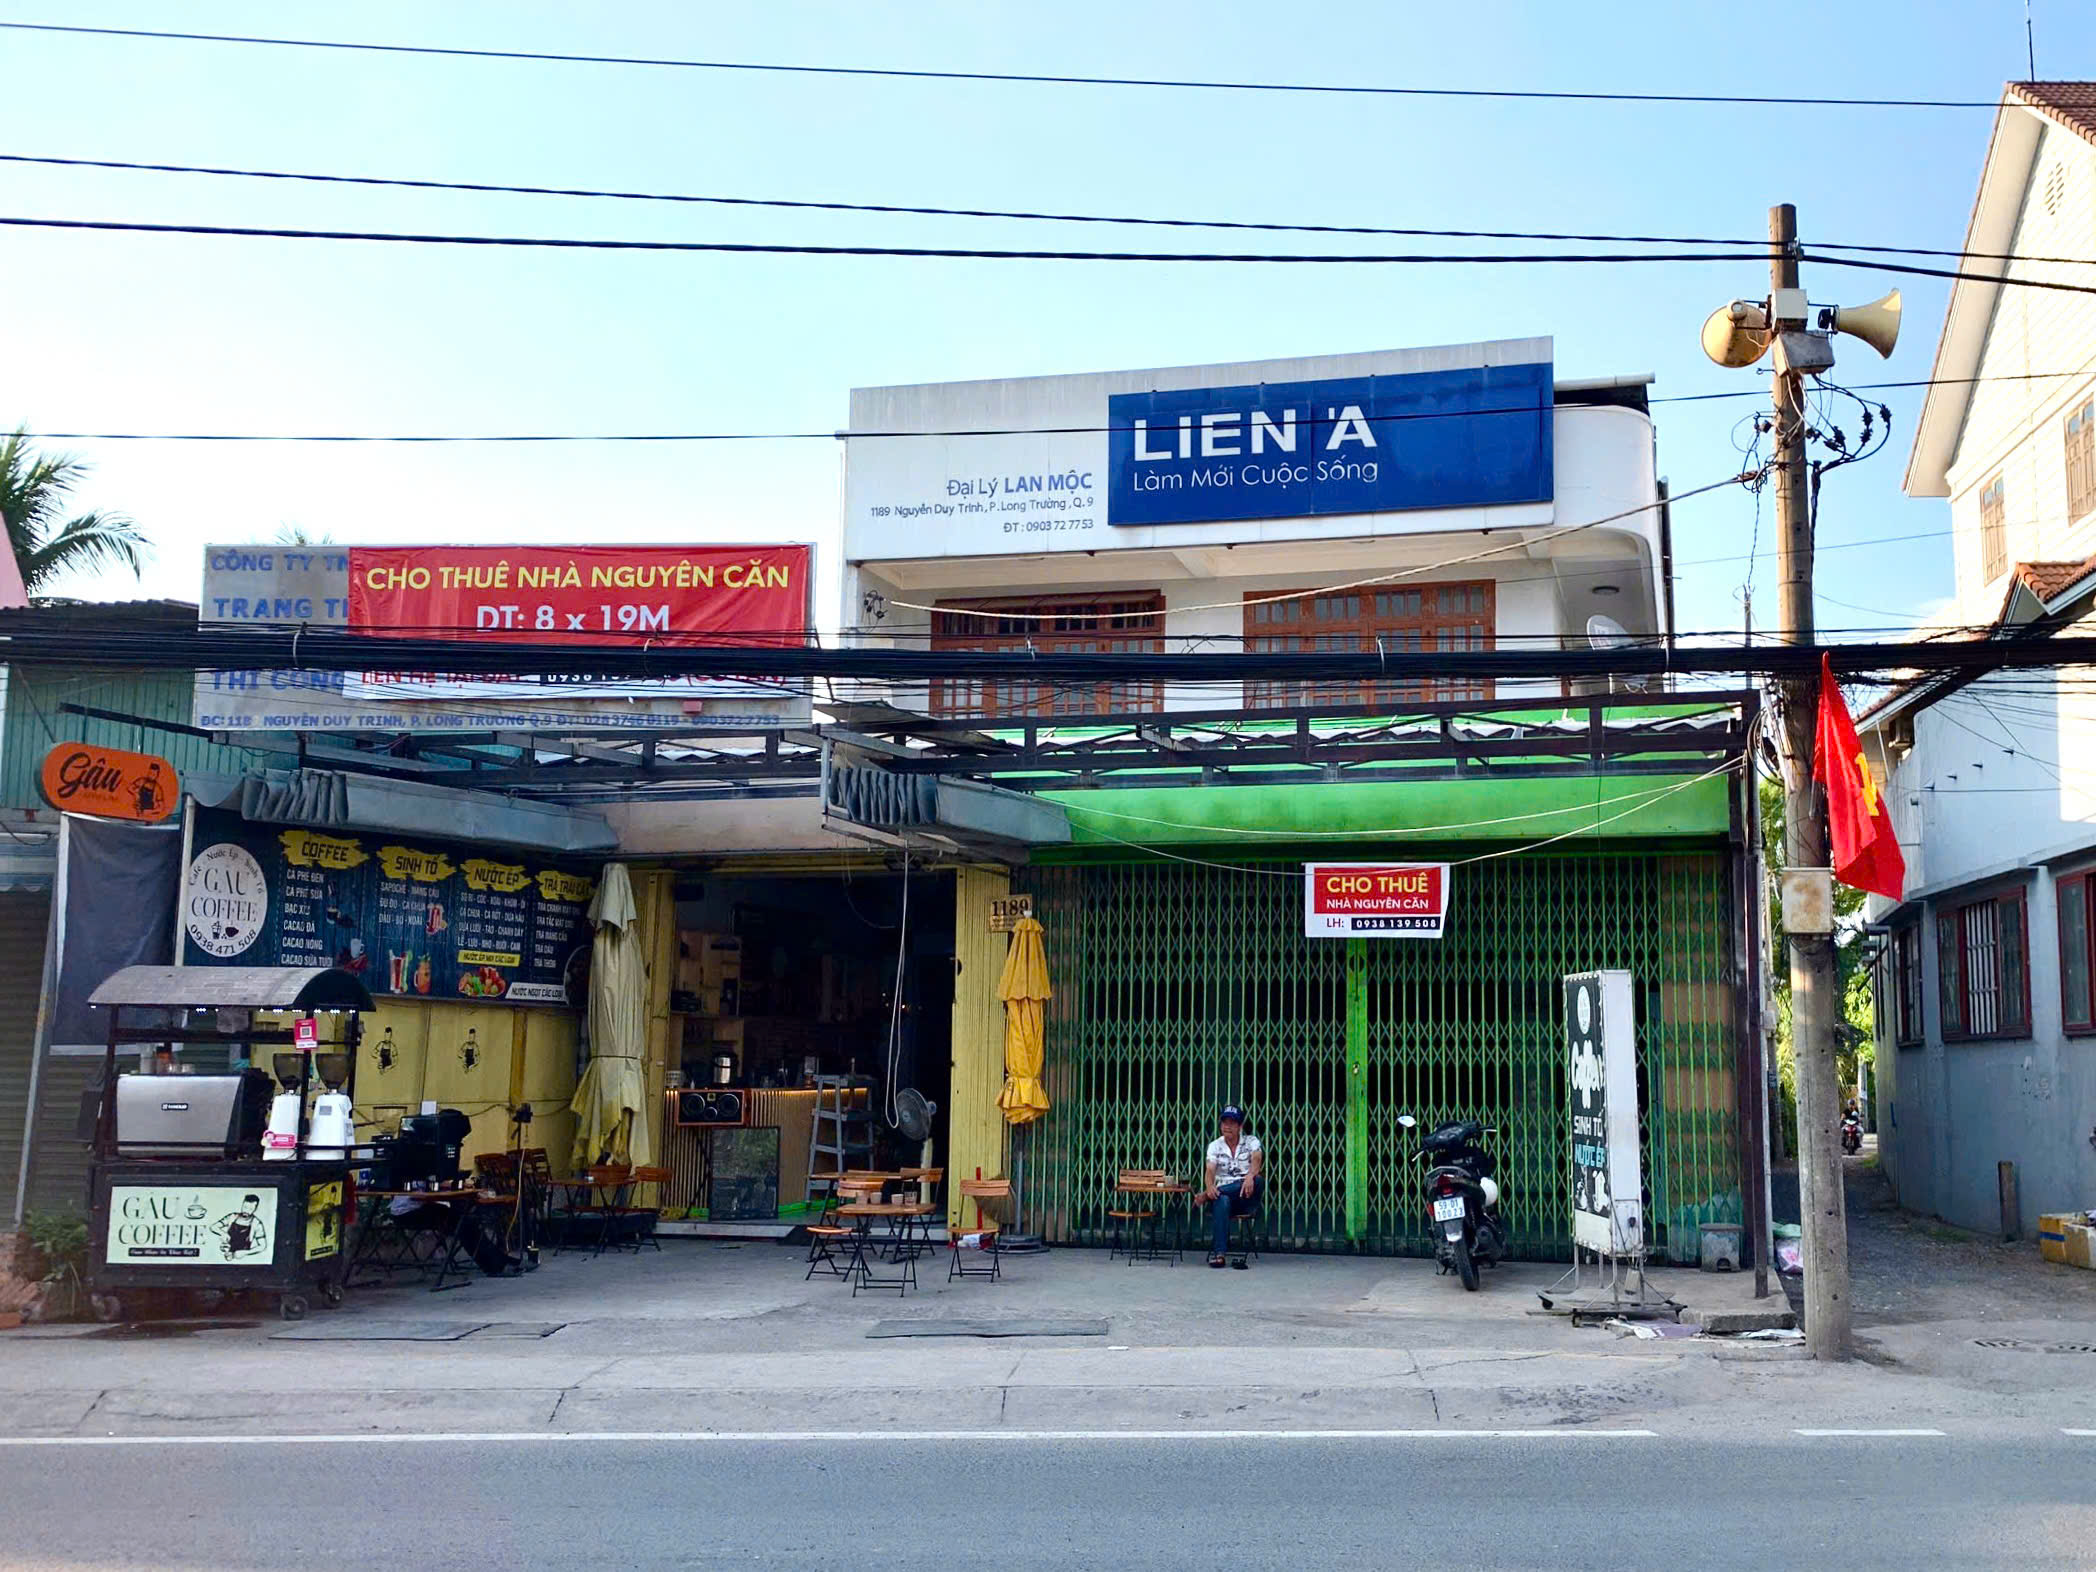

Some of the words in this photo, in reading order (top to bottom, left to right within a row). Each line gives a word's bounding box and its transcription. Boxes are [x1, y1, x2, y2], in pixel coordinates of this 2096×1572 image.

[1134, 408, 1296, 462] LIEN
[946, 479, 974, 499] Đại
[978, 477, 998, 498] Lý
[1004, 475, 1042, 493] LAN
[1048, 469, 1093, 494] MỘC
[1134, 470, 1183, 492] Làm
[1191, 464, 1234, 487] Mới
[1241, 462, 1309, 489] Cuộc
[1316, 455, 1378, 483] Sống
[871, 506, 891, 517] 1189
[934, 503, 955, 516] Duy
[1026, 521, 1052, 532] 0903
[1068, 518, 1094, 530] 7753
[211, 549, 273, 572] CÔNG
[284, 555, 313, 571] TY
[367, 567, 431, 591] CHO
[439, 561, 508, 589] THUÊ
[518, 560, 582, 588] NHÀ
[591, 561, 714, 589] NGUYÊN
[723, 559, 789, 589] CĂN
[213, 598, 313, 619] TRANG
[535, 605, 555, 631] 8
[565, 612, 586, 630] x
[600, 605, 670, 632] 19M
[211, 671, 259, 690] THI
[323, 715, 353, 726] DUY
[426, 714, 463, 726] LONG
[301, 841, 349, 862] COFFEE
[395, 856, 422, 873] SINH
[425, 855, 440, 875] TỐ
[474, 867, 505, 884] NƯỚC
[506, 870, 520, 886] ÉP
[1327, 876, 1372, 893] CHO
[1377, 871, 1429, 893] THUÊ
[191, 896, 258, 922] COFFEE
[992, 898, 1029, 917] 1189
[1326, 896, 1352, 909] NHÀ
[1354, 896, 1401, 909] NGUYÊN
[1403, 897, 1429, 909] CĂN
[283, 919, 305, 932] CACAO
[1326, 918, 1344, 928] LH:
[1356, 919, 1385, 928] 0938
[1389, 919, 1411, 928] 139
[1415, 919, 1437, 928] 508
[190, 924, 215, 952] 0938
[215, 945, 236, 955] 471
[238, 929, 257, 950] 508
[282, 936, 304, 949] CACAO
[281, 953, 303, 966] CACAO
[1573, 1115, 1592, 1136] SINH
[1574, 1139, 1596, 1167] NƯỚC
[118, 1224, 207, 1246] COFFEE
